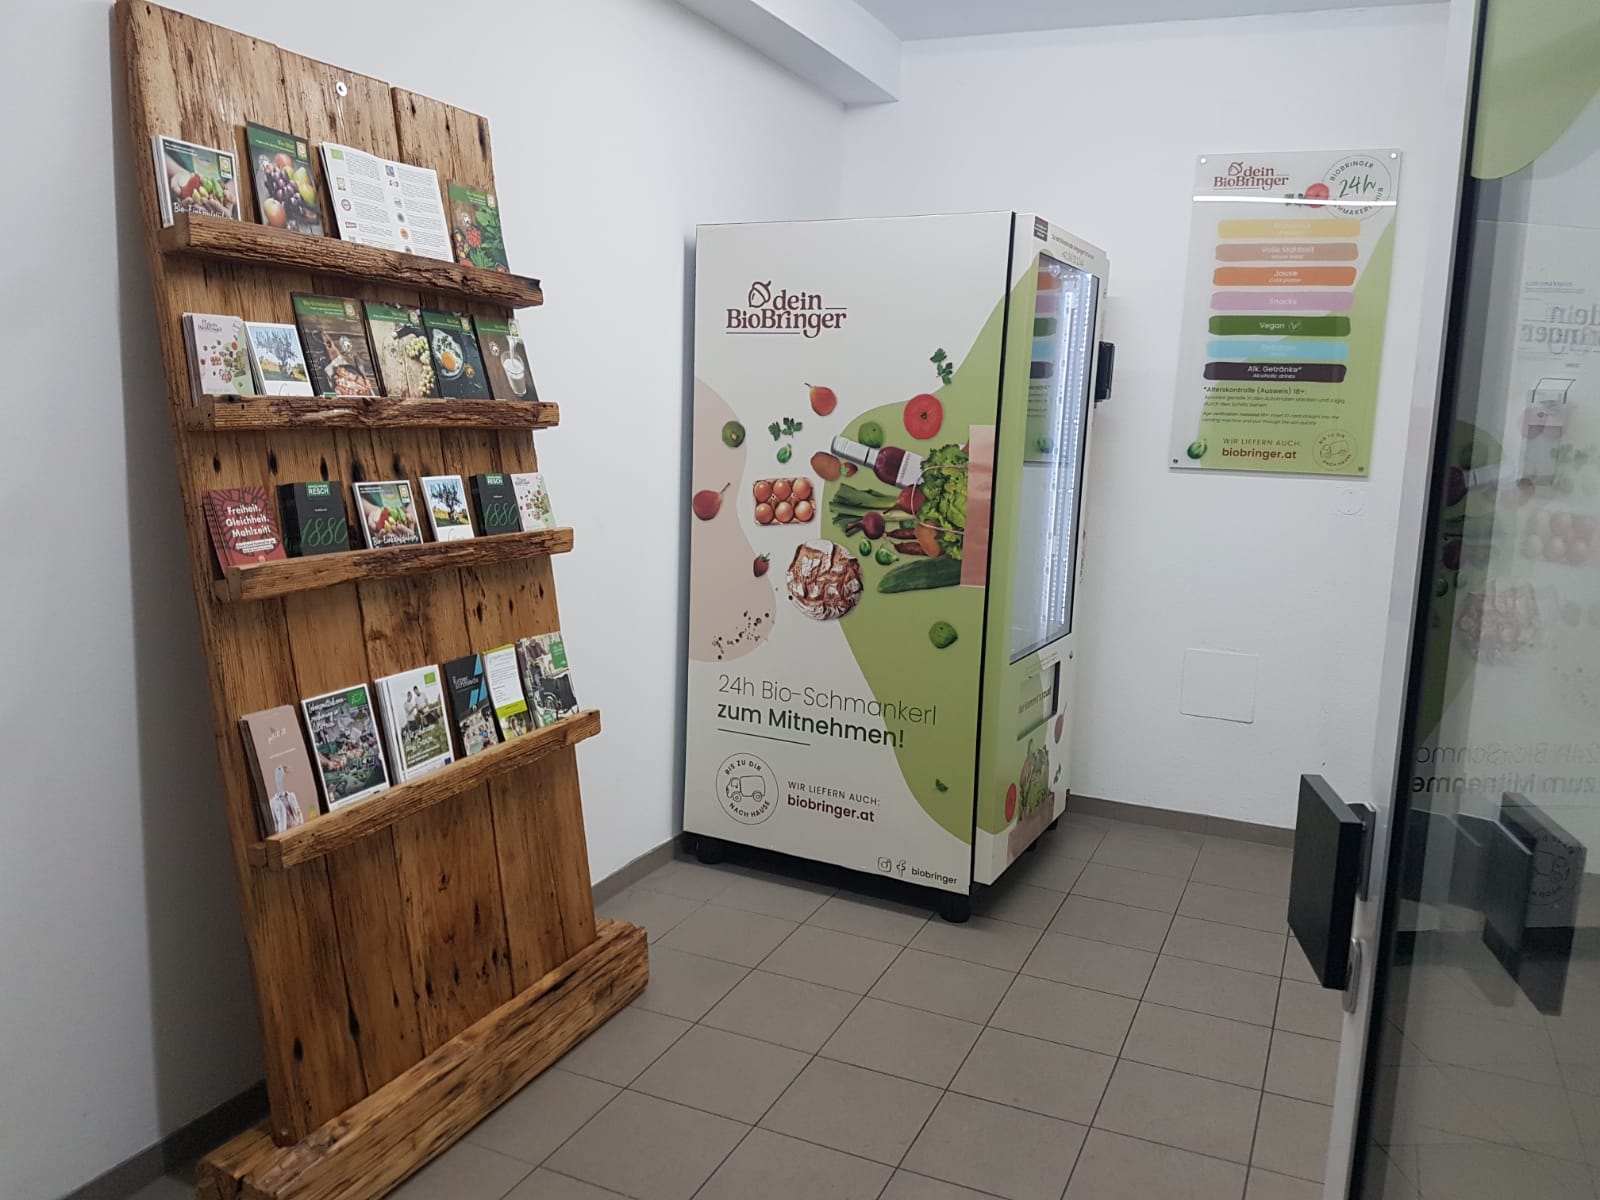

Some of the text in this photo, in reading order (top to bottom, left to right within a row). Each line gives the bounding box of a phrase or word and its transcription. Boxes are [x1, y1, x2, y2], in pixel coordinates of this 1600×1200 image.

[1243, 165, 1275, 177] dein
[1213, 175, 1290, 191] BioBringer
[1339, 174, 1377, 198] 24h
[773, 289, 823, 311] dein
[725, 308, 847, 339] BioBringer
[1259, 321, 1286, 330] Vegan
[1222, 447, 1297, 461] biobringer.at
[226, 503, 262, 516] Freiheit.
[225, 513, 271, 527] Gleichheit.
[231, 525, 272, 539] Mahlzeit!
[718, 673, 937, 726] 24h Bio-Schmankerl
[717, 702, 905, 749] zum Mitnehmen!
[724, 759, 762, 776] BIS ZU DIR
[787, 780, 881, 807] WIR LIEFERN AUCH:
[729, 799, 770, 818] NACH HAUSE
[787, 793, 876, 823] biobringer.at
[911, 865, 959, 886] biobringer
